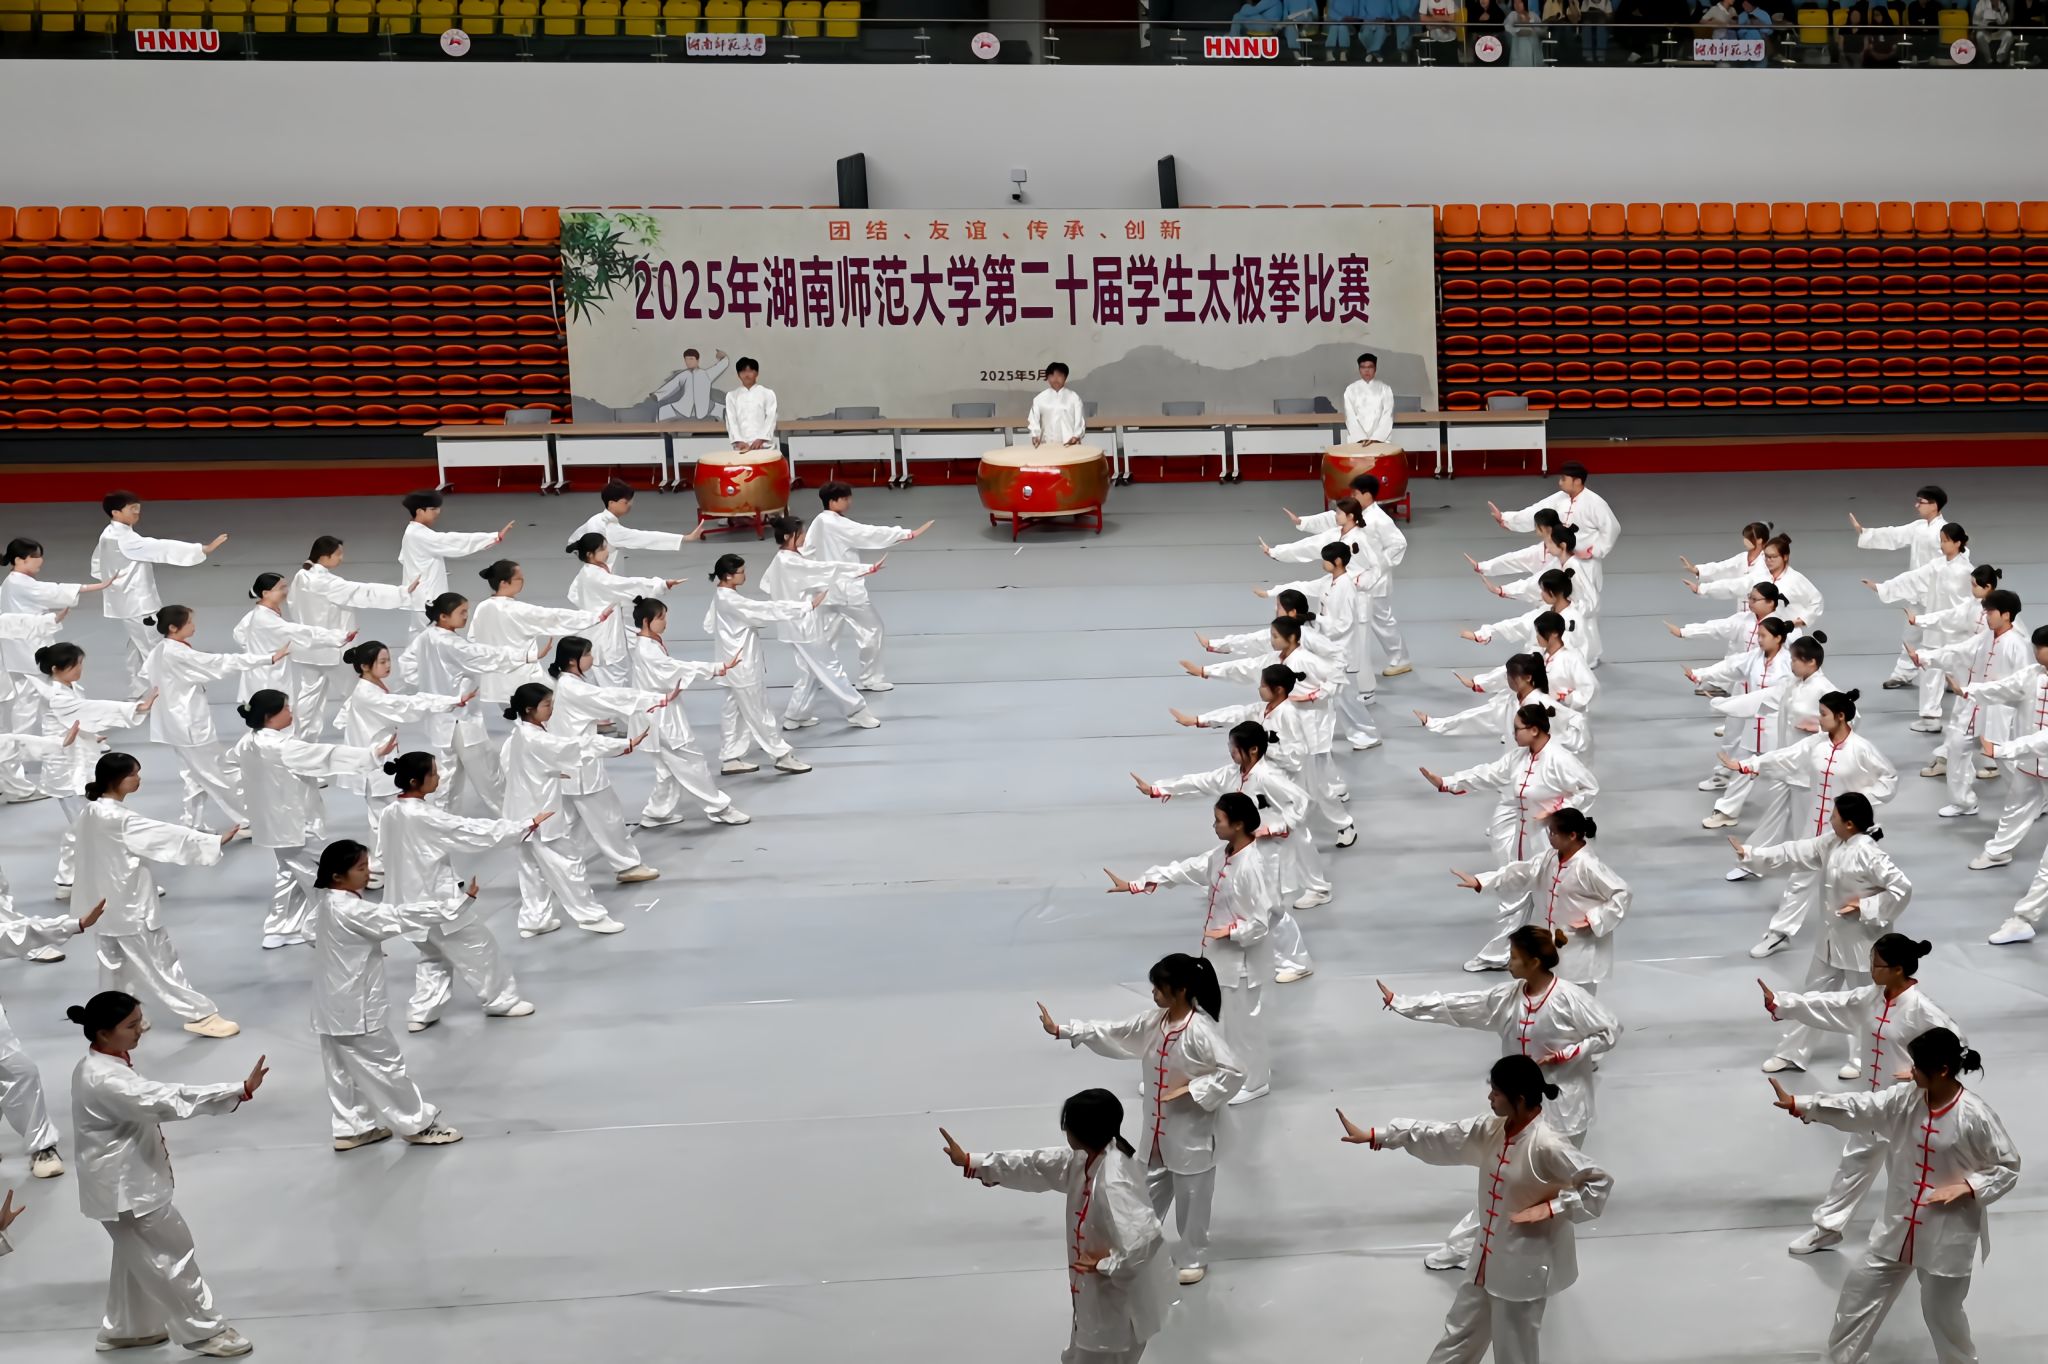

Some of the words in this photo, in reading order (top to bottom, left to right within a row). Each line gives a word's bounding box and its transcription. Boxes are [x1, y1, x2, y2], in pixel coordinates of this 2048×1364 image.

[136, 30, 218, 51] HNNU
[1205, 37, 1278, 57] HNNU
[828, 219, 1182, 241] 团结、友谊、传承、创新
[633, 253, 1370, 328] 2025年湖南师范大学第二十届学生太极拳比赛
[980, 369, 1048, 381] 2025年5月
